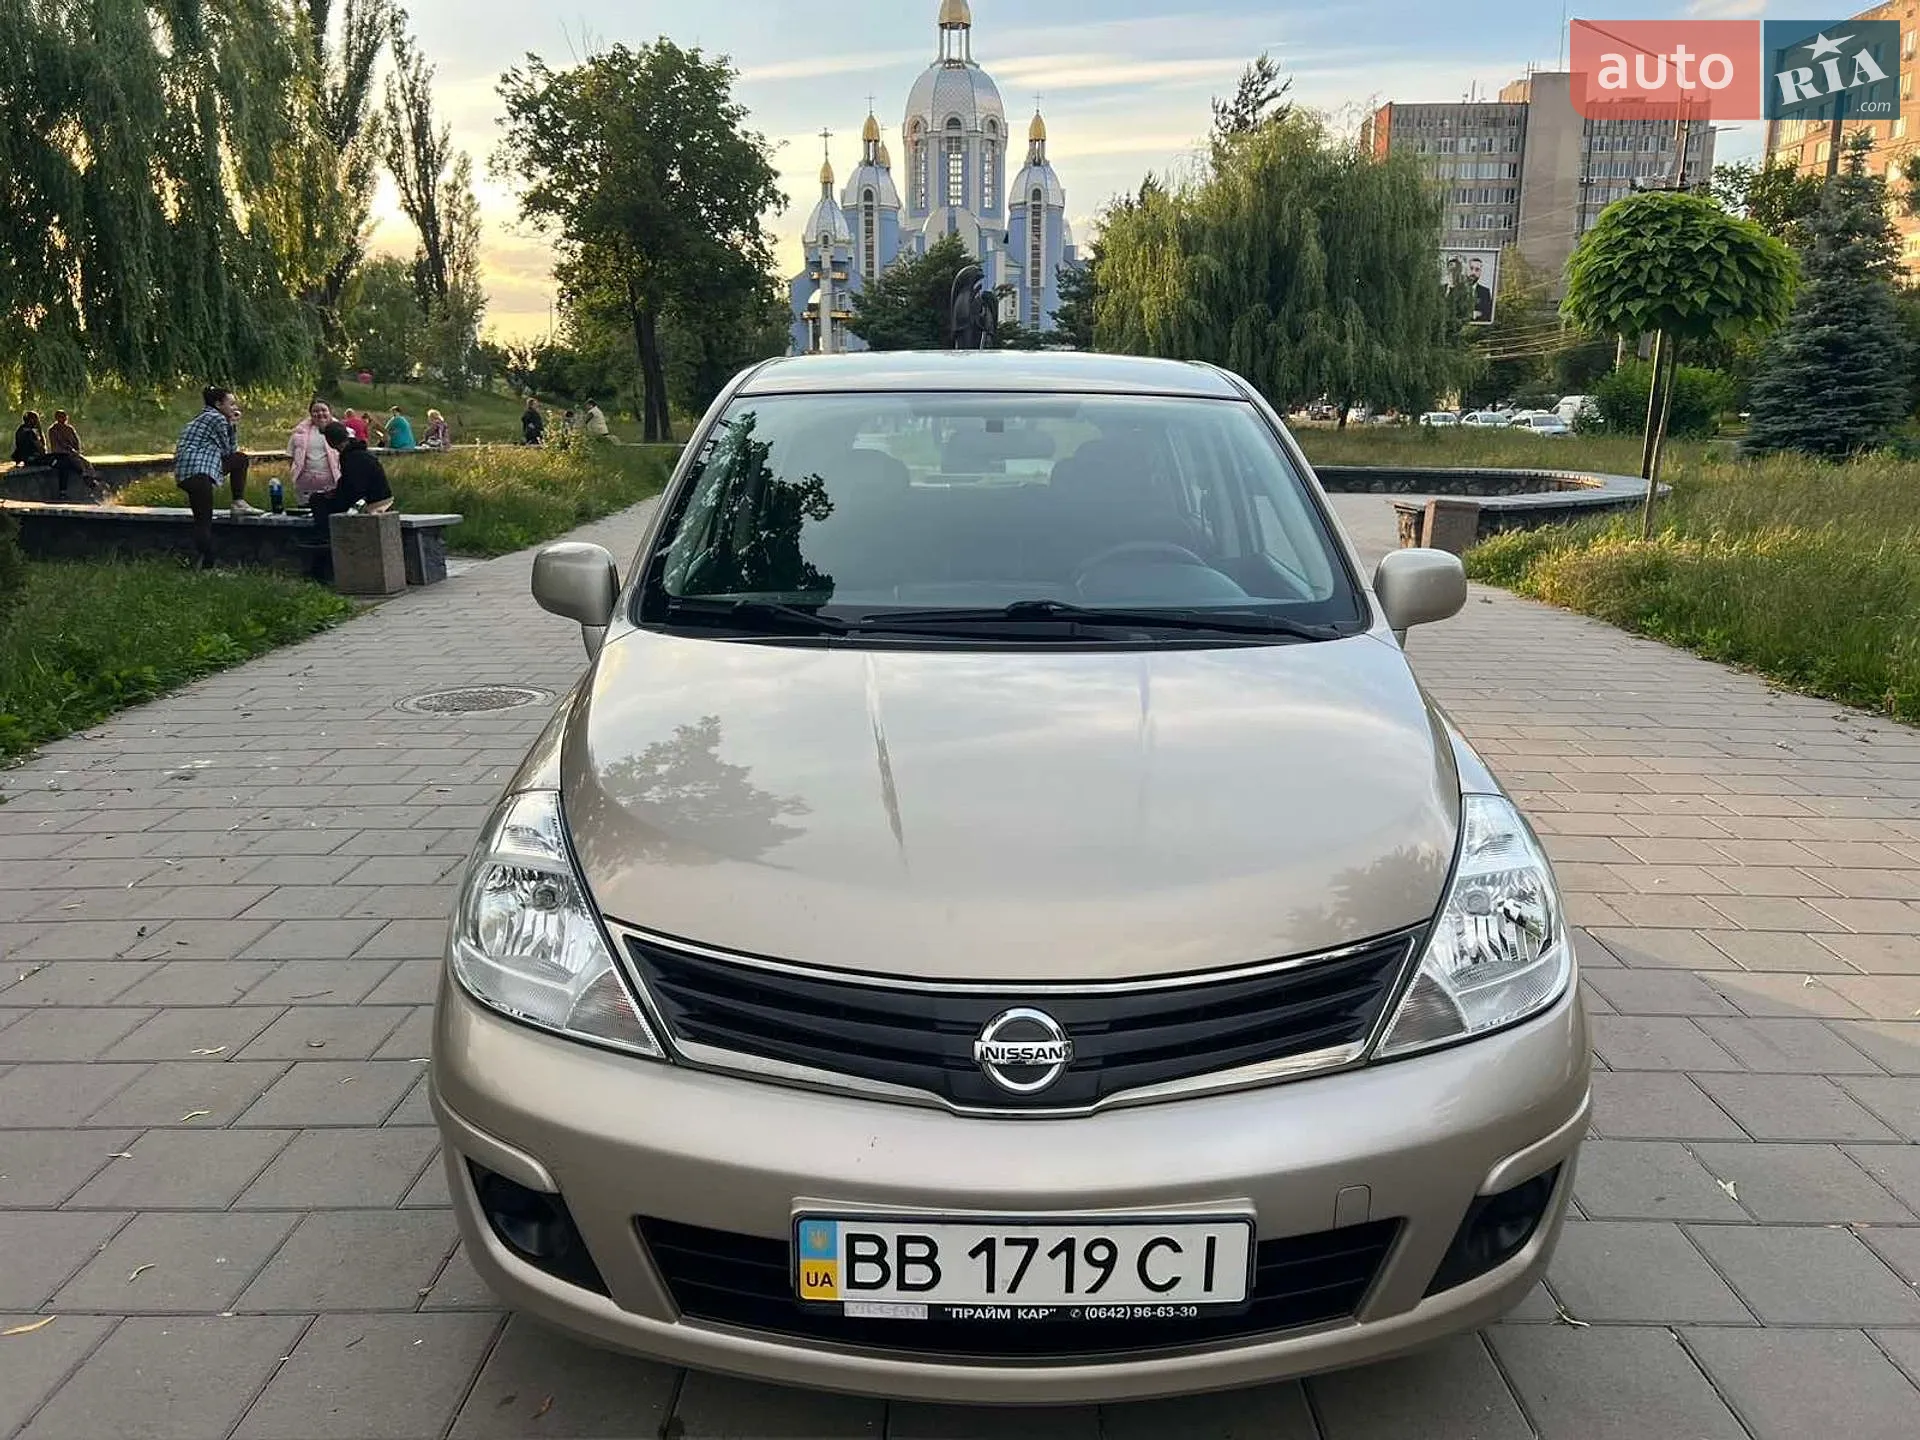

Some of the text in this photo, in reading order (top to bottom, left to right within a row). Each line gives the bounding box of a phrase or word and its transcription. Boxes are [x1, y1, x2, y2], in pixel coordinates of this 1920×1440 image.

[985, 1047, 1062, 1060] NISSAN
[845, 1233, 941, 1292] BB
[967, 1236, 1118, 1294] 1719
[806, 1272, 833, 1288] UA
[944, 1306, 1198, 1320] "ПРАЙМ КАР" (0642) 96-63-30
